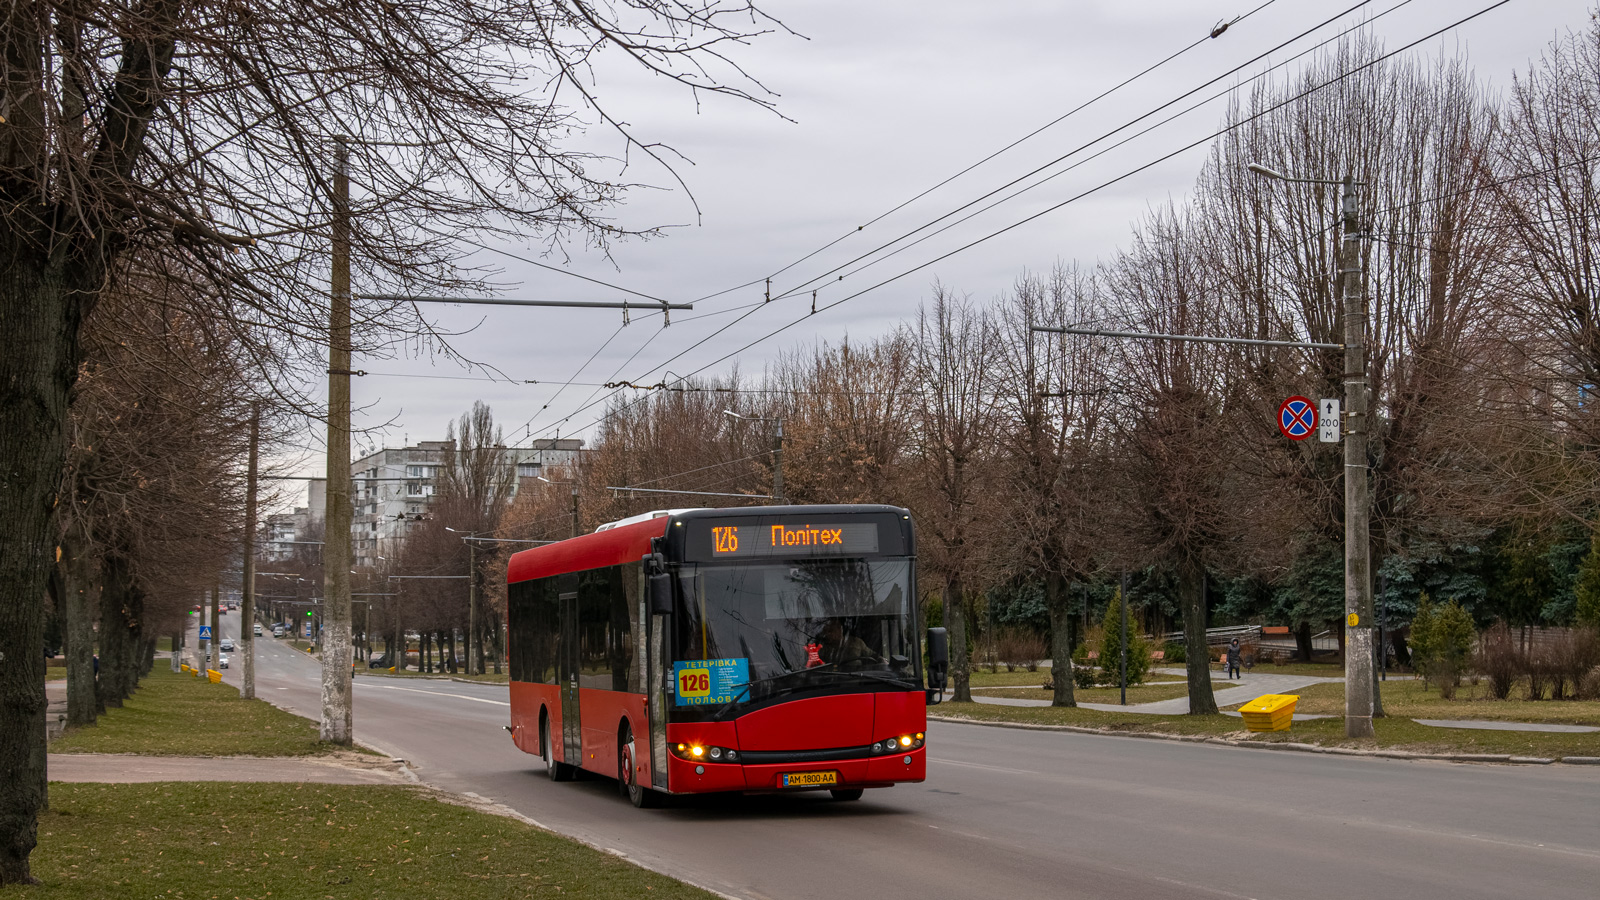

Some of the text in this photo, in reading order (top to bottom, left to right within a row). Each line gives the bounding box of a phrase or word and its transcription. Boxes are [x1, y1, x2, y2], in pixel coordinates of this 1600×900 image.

[1321, 418, 1338, 428] 200
[712, 524, 843, 552] 126 Політех
[685, 660, 737, 668] ТЕТЕРІВКА
[680, 674, 709, 692] 126
